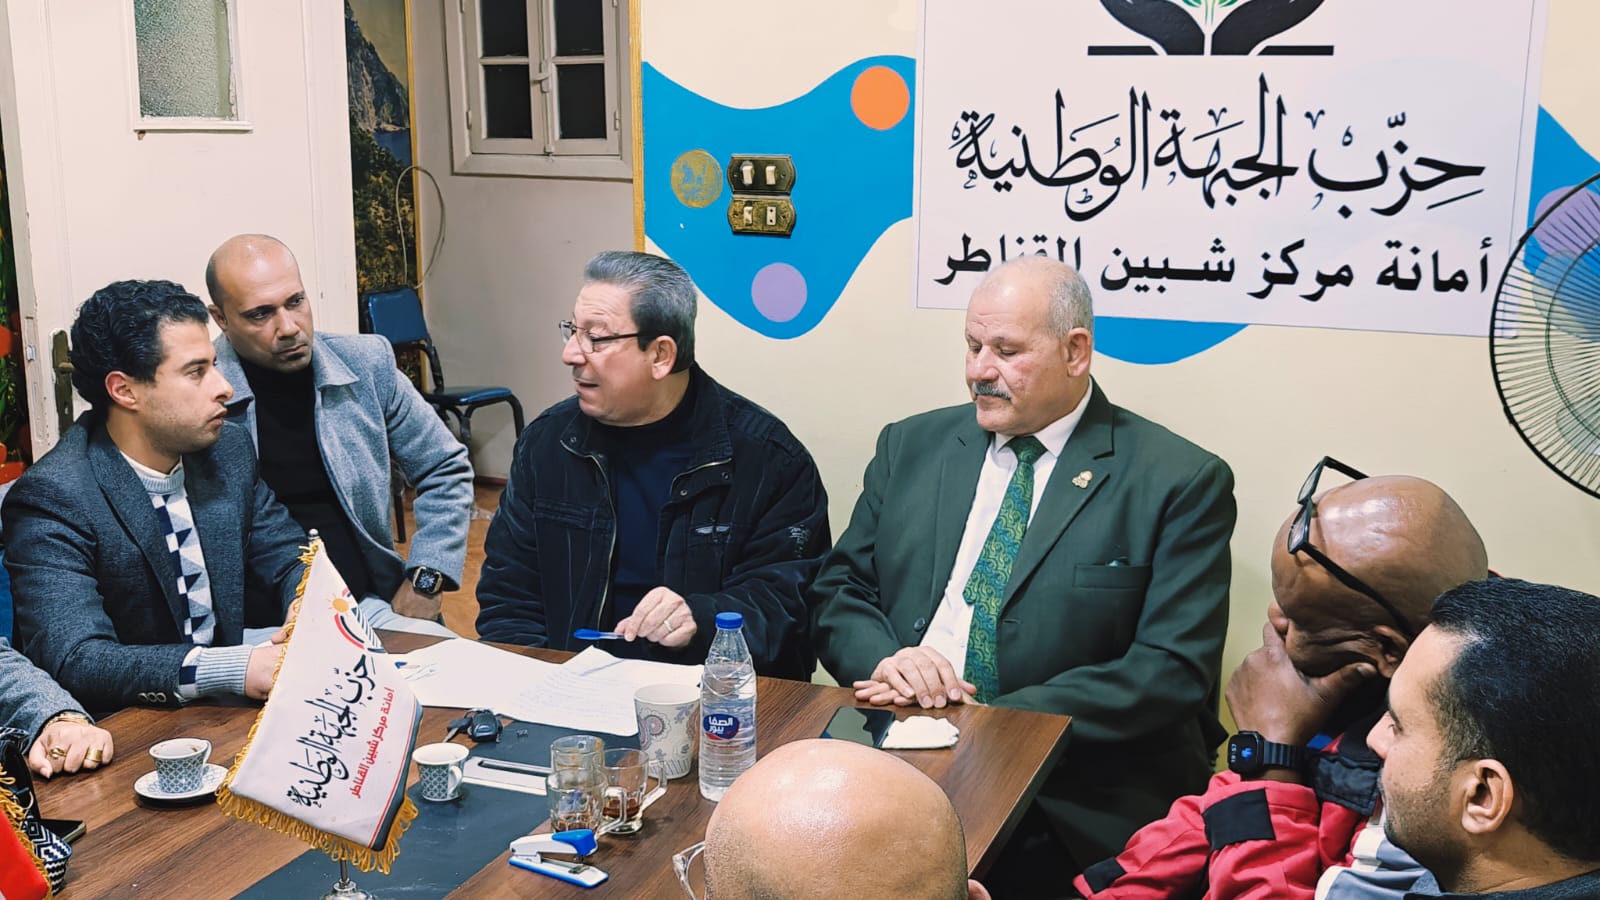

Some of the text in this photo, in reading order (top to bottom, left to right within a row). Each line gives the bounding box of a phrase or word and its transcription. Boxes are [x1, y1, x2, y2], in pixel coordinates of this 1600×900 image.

[949, 86, 1151, 222] الوطنية
[1154, 72, 1299, 209] الجبهة
[1100, 237, 1235, 293] شبين
[1246, 238, 1354, 302] مركز
[1376, 237, 1493, 293] أمانة
[708, 716, 733, 726] الصفا
